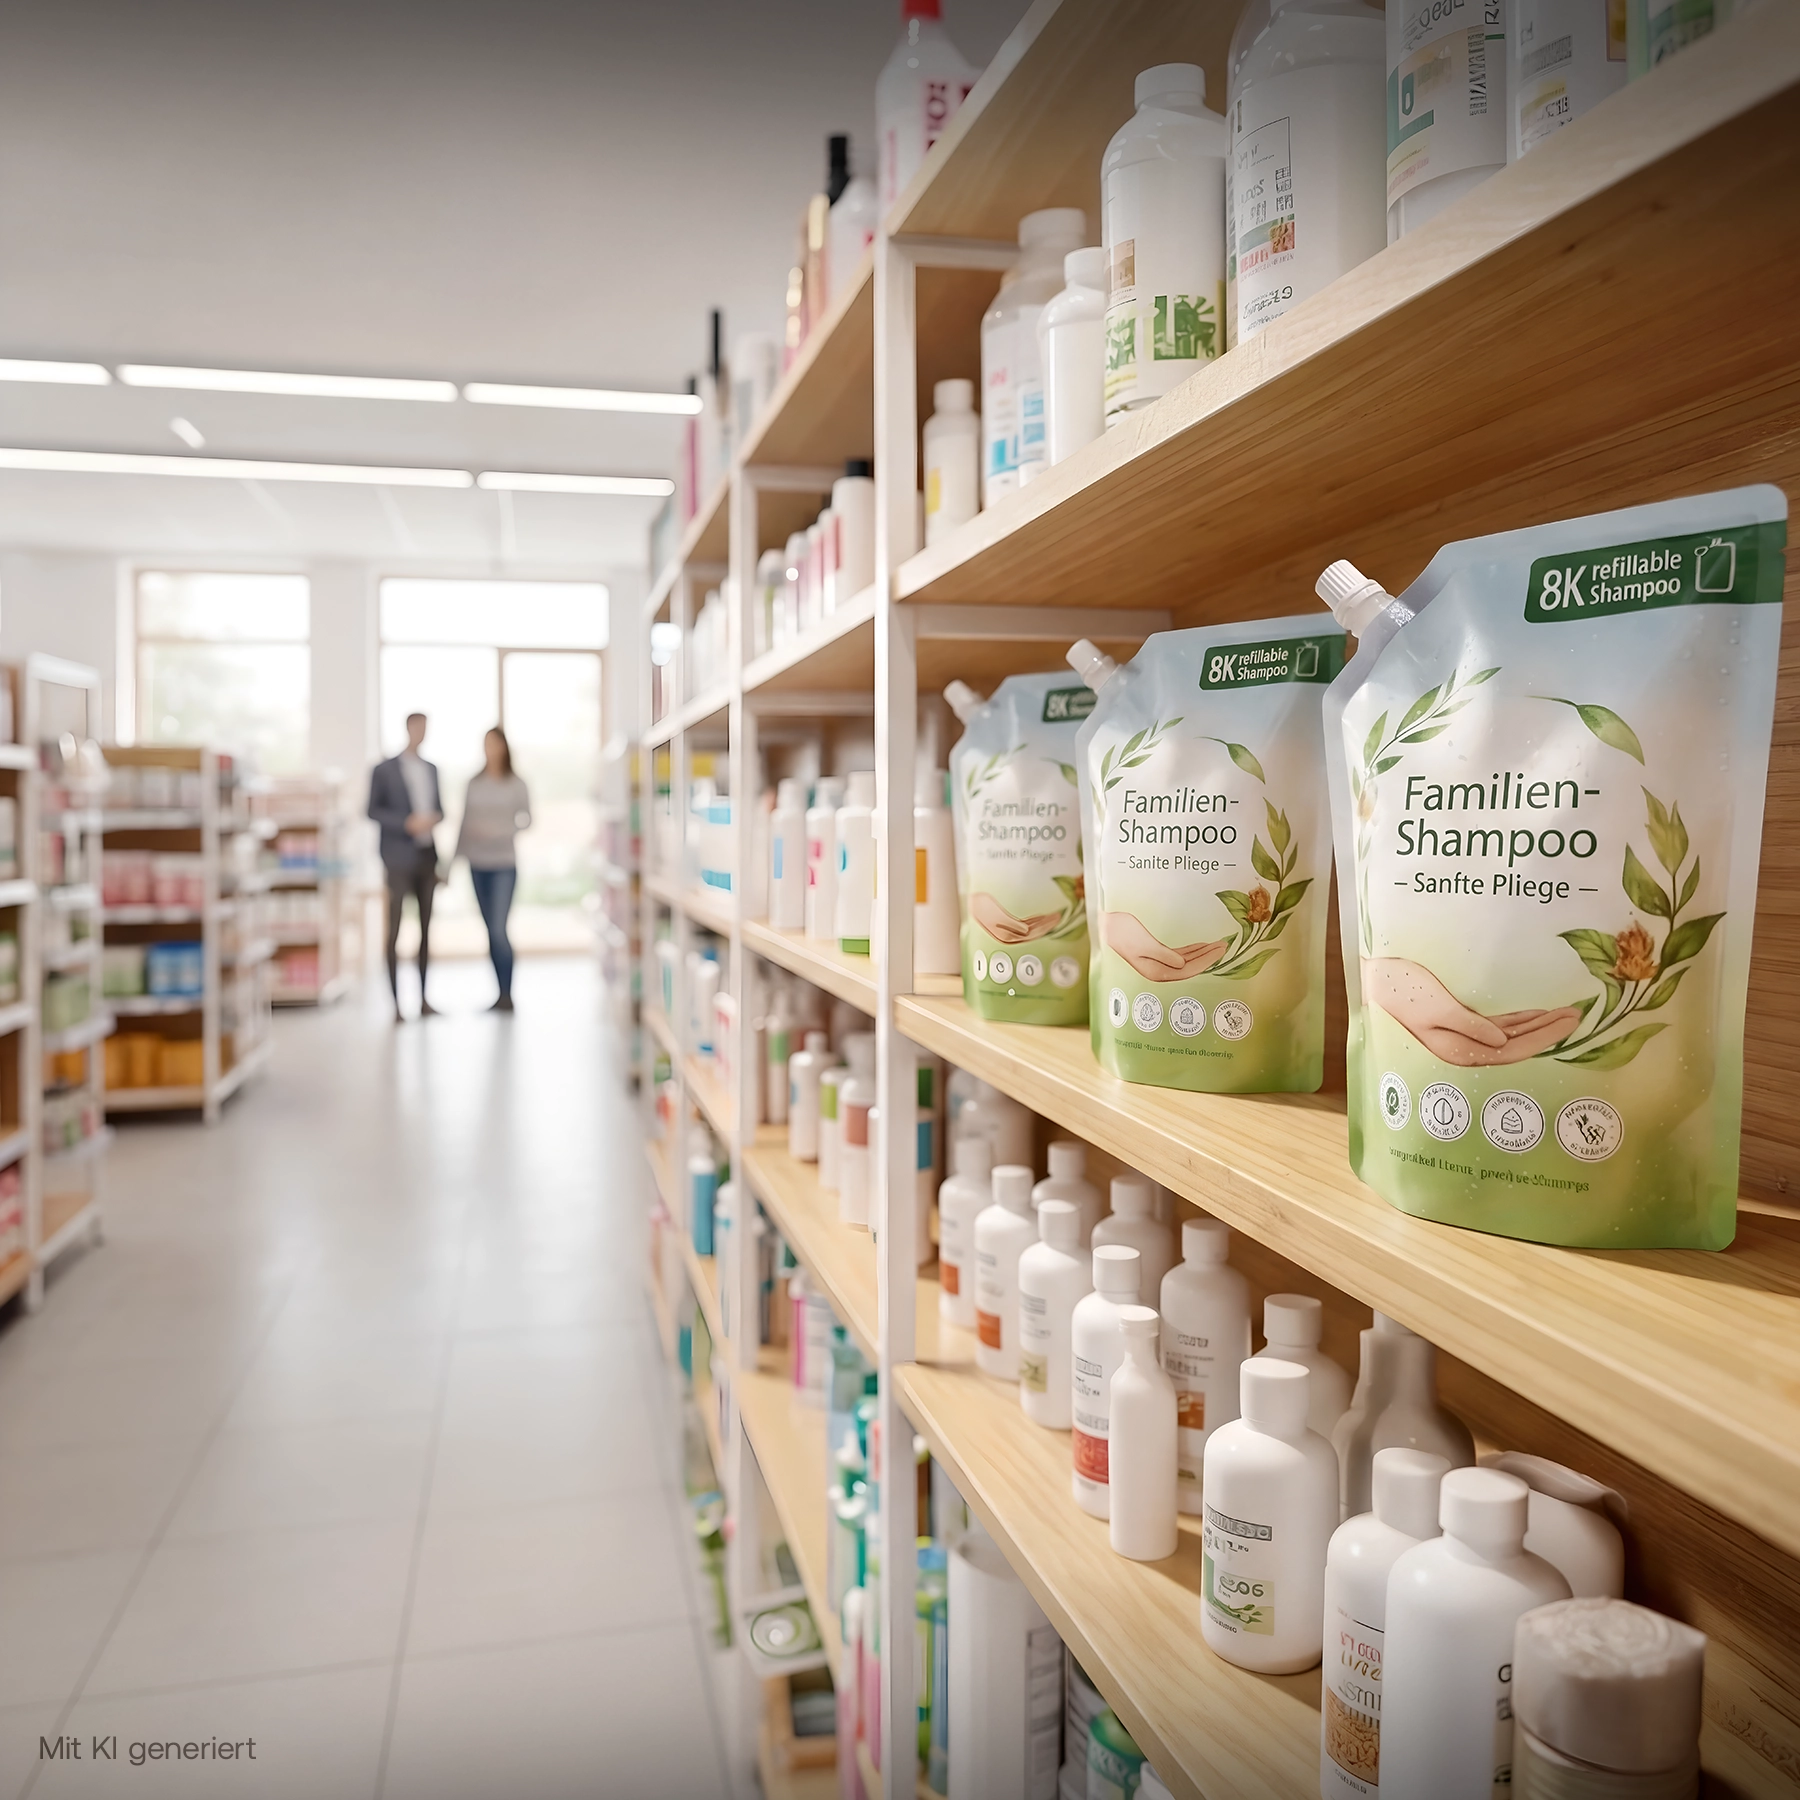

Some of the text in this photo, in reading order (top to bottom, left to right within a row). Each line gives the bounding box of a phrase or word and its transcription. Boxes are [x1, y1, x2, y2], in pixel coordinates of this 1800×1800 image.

[1592, 549, 1682, 581] refillable
[1539, 565, 1587, 611] 8K
[1589, 577, 1681, 605] Shampoo
[1208, 654, 1238, 683] 8K
[1236, 665, 1288, 681] Shampoo
[1123, 787, 1239, 813] Familien-
[1405, 772, 1600, 811] Familien-
[978, 820, 1067, 845] Shampoo
[1118, 819, 1237, 851] Shampoo
[1396, 818, 1598, 868] Shampoo
[1413, 872, 1570, 904] Sanfte Pliege
